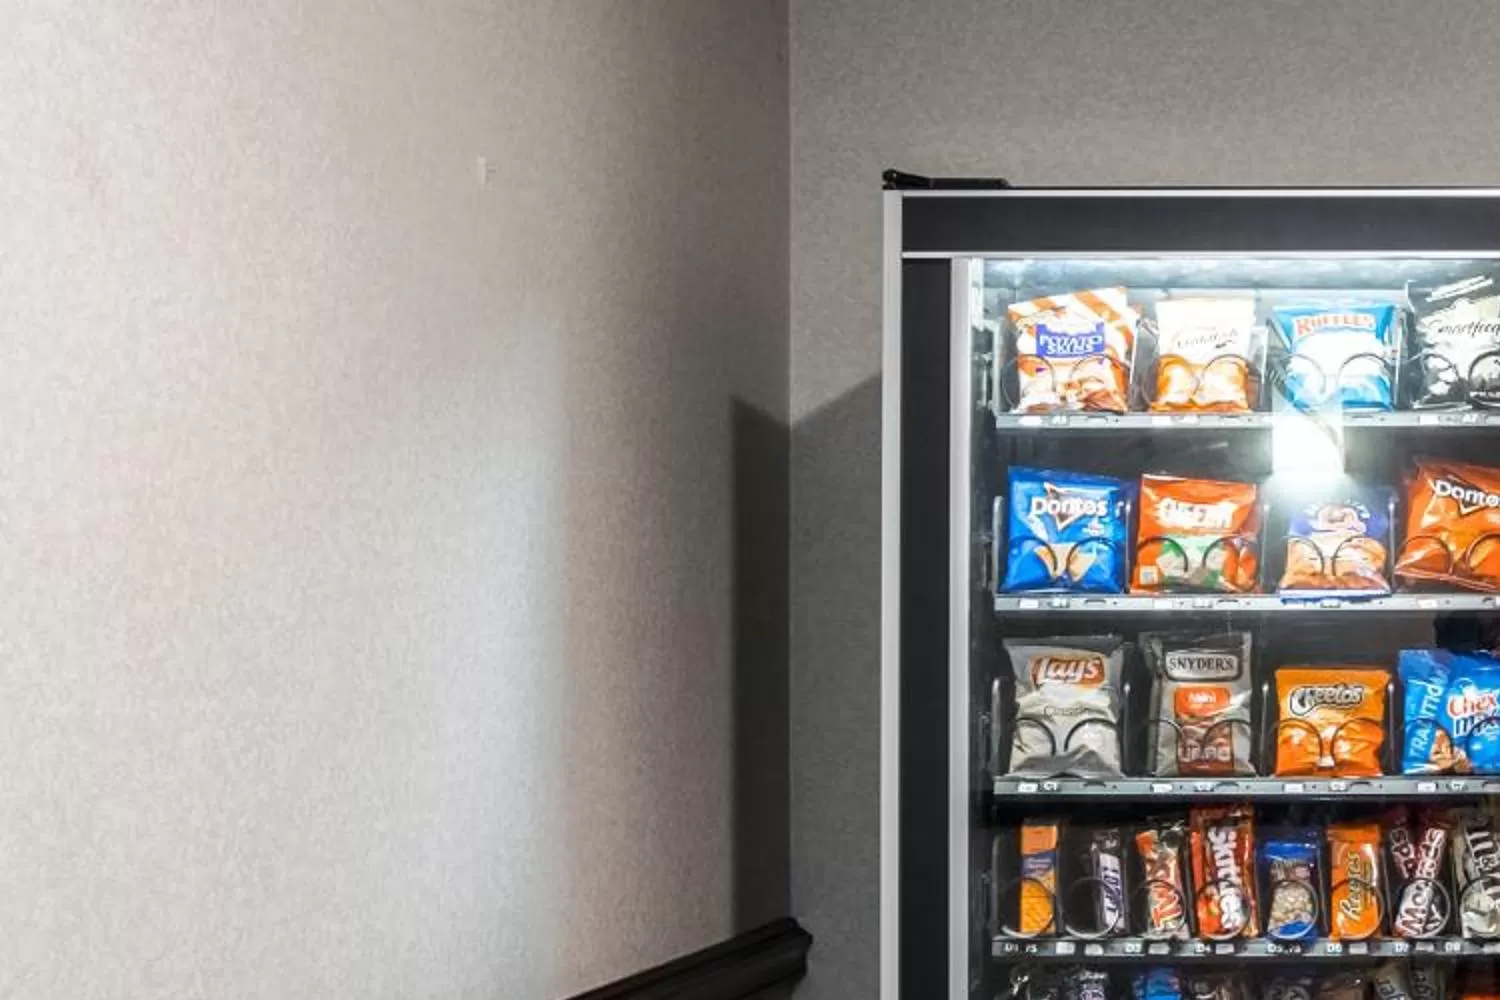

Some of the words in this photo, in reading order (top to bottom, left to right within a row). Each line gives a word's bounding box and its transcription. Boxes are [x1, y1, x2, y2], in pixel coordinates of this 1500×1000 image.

[1039, 334, 1103, 347] POTATO
[1047, 344, 1095, 355] SKINS
[1032, 496, 1108, 517] Doritos
[1291, 685, 1364, 716] Cheetos
